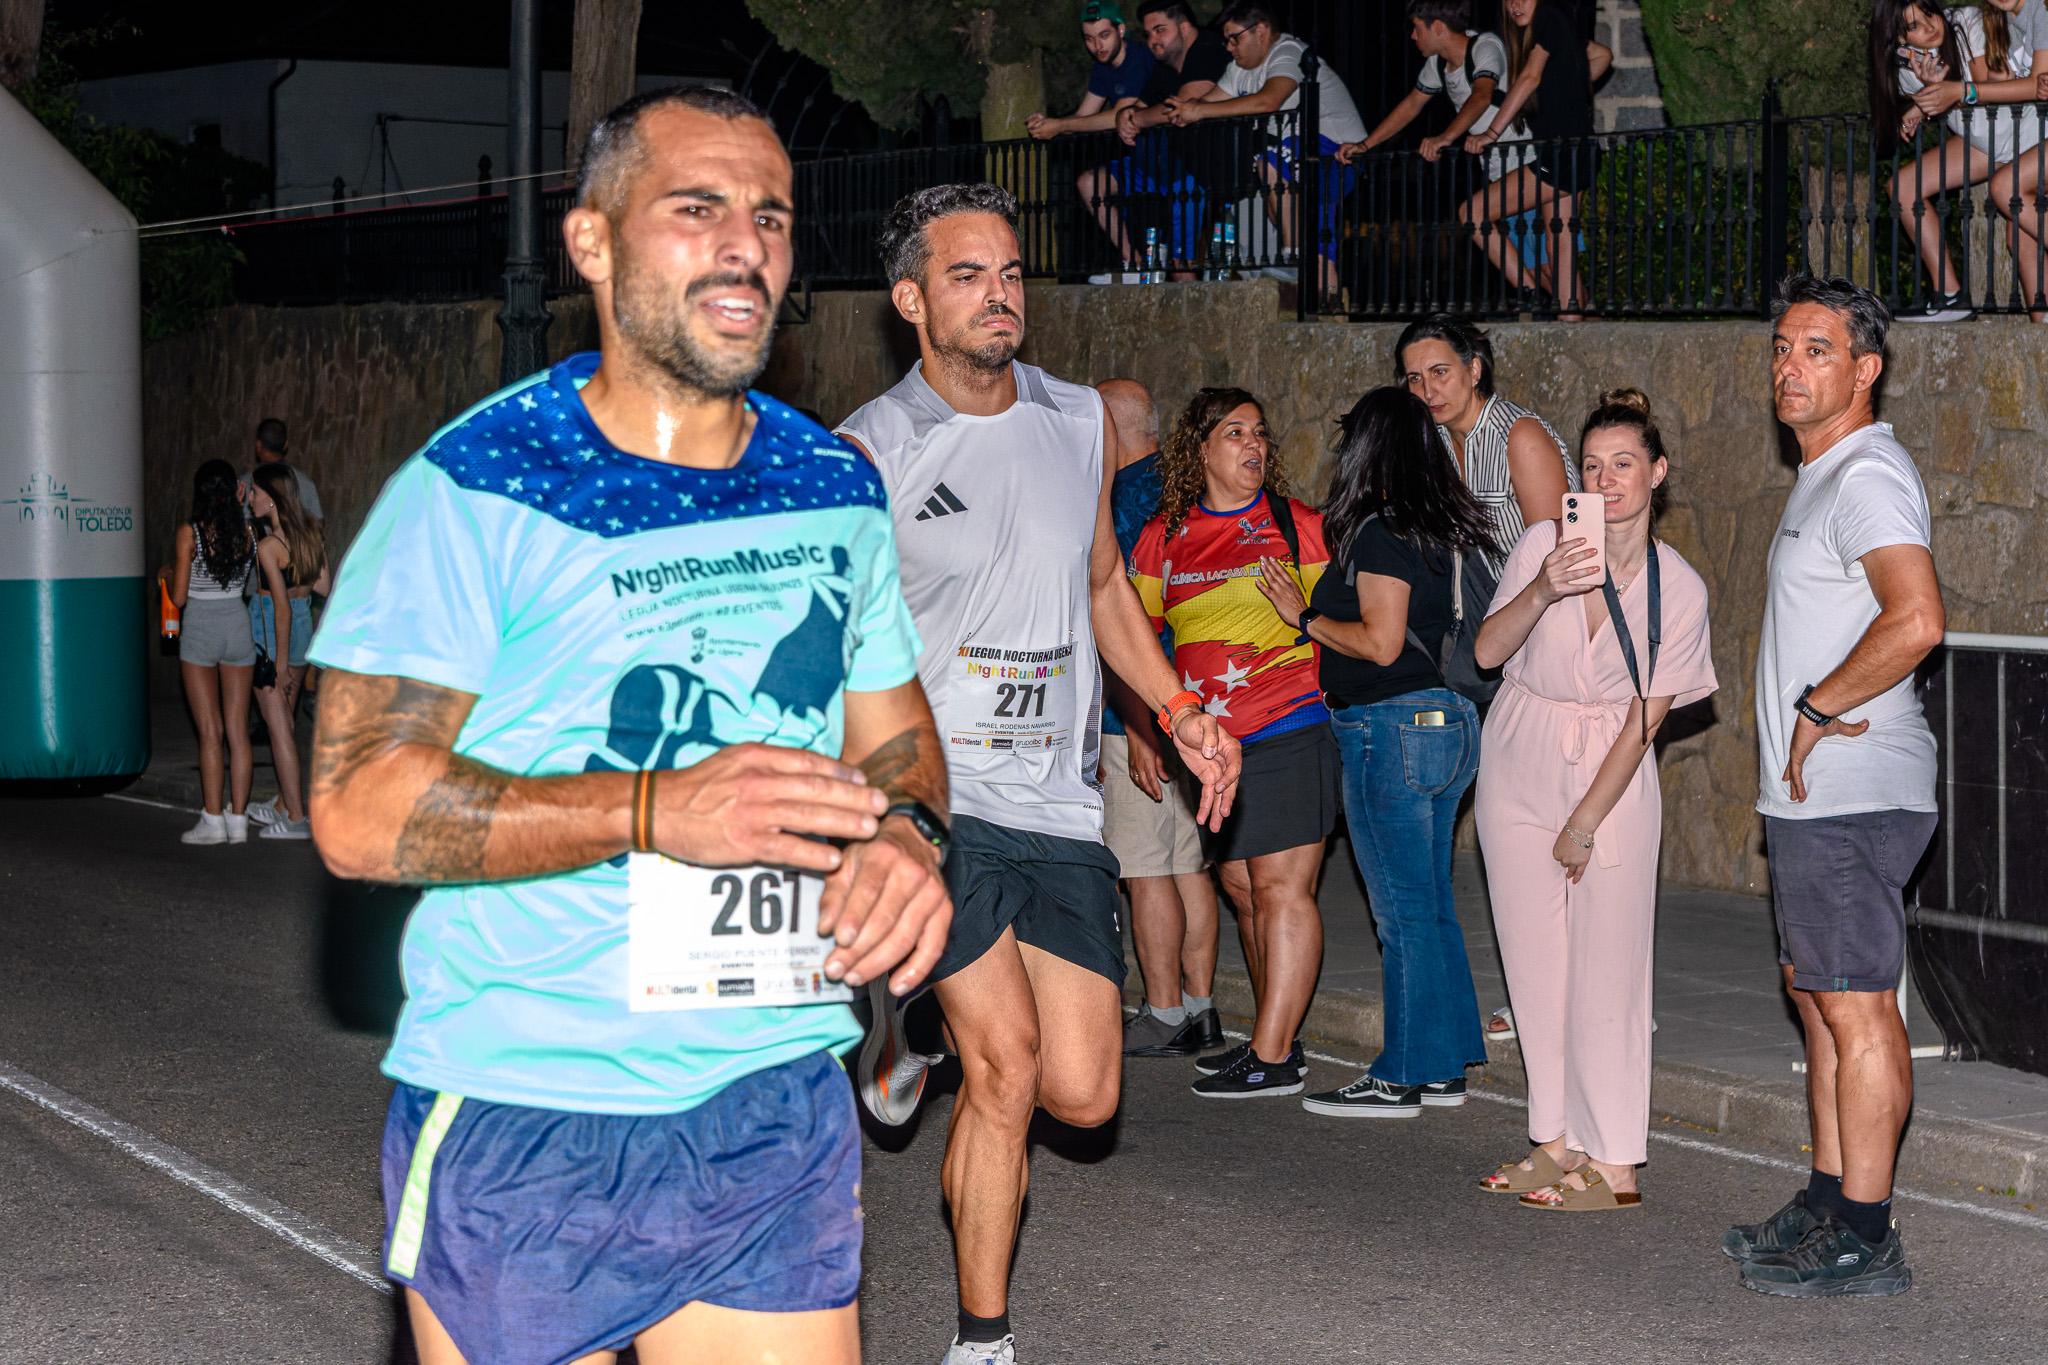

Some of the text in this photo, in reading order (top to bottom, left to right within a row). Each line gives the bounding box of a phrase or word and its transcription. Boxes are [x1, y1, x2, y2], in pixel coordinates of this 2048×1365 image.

[76, 516, 133, 532] TOLEDO
[611, 543, 825, 598] NightRunMusic
[1206, 567, 1248, 580] LACASA
[957, 646, 970, 657] XI
[969, 647, 1001, 660] LEGUA
[1003, 650, 1053, 663] NOCTURNA
[994, 683, 1046, 718] 271
[975, 722, 998, 730] ISRAEL
[1030, 721, 1056, 730] NAVARRO
[951, 737, 982, 746] MULTIdental
[711, 871, 800, 936] 267
[688, 951, 730, 960] SERGIO
